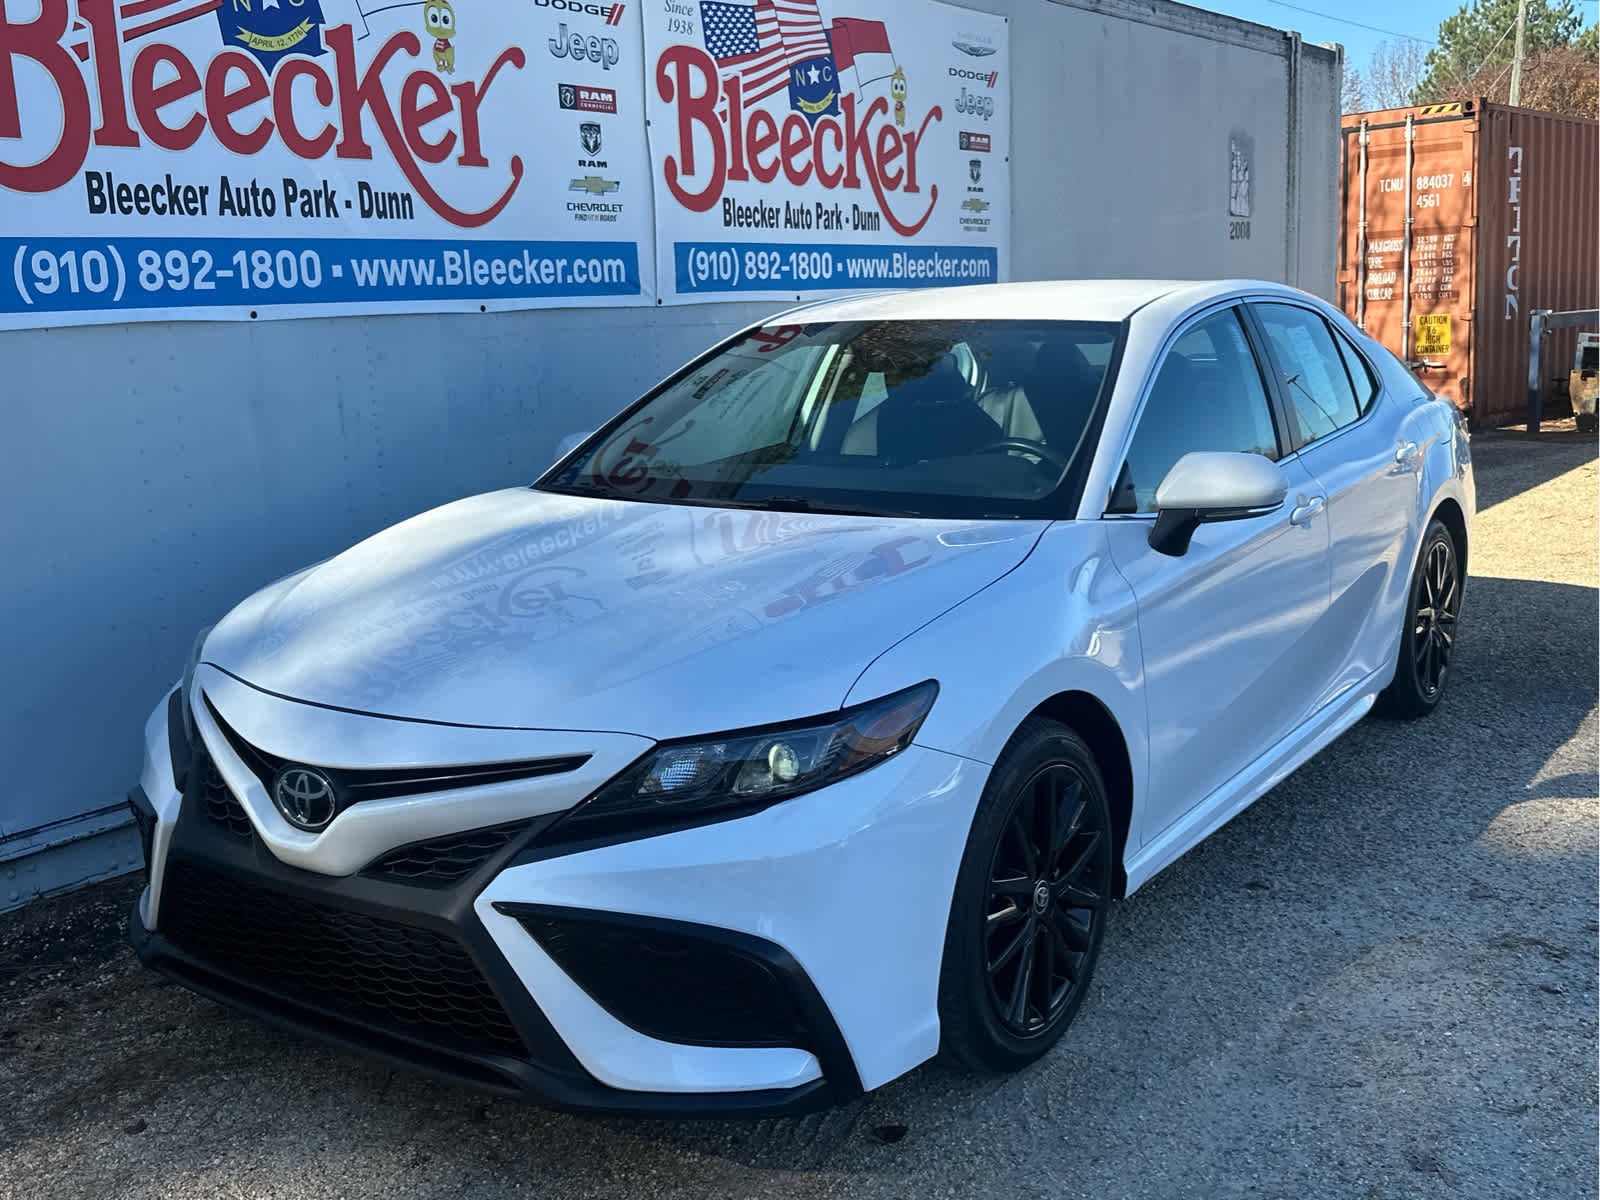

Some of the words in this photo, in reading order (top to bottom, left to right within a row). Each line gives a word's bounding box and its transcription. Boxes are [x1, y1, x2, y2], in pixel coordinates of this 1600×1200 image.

[534, 0, 614, 18] DODGE
[664, 0, 695, 16] Since
[667, 17, 694, 36] 1938
[251, 37, 275, 48] APRIL
[548, 22, 620, 70] Jeep
[795, 68, 806, 87] N
[948, 67, 993, 82] DODGE
[579, 90, 613, 102] RAM
[954, 87, 994, 121] Jeep
[655, 45, 943, 238] Bleecker
[577, 159, 608, 168] RAM
[1379, 177, 1404, 193] TCNU
[1415, 173, 1455, 190] 884037
[85, 171, 210, 217] Bleecker
[218, 175, 277, 218] Auto
[284, 179, 339, 220] Park
[359, 181, 415, 221] Dunn
[566, 201, 624, 213] CHEVROLET
[722, 197, 781, 228] Bleecker
[784, 200, 813, 230] Auto
[816, 202, 843, 231] Park
[852, 203, 881, 232] Dunn
[959, 217, 991, 226] CHEVROLET
[13, 245, 126, 304] (910)
[138, 249, 323, 291] 892-1800
[350, 248, 627, 287] www.Bleecker.com
[688, 247, 739, 287] (910)
[744, 250, 833, 280] 892-1800
[846, 251, 991, 279] www.Bleecker.com
[1419, 315, 1448, 326] CAUTION
[1416, 344, 1450, 354] CONTAINER
[1425, 335, 1441, 345] HIGH
